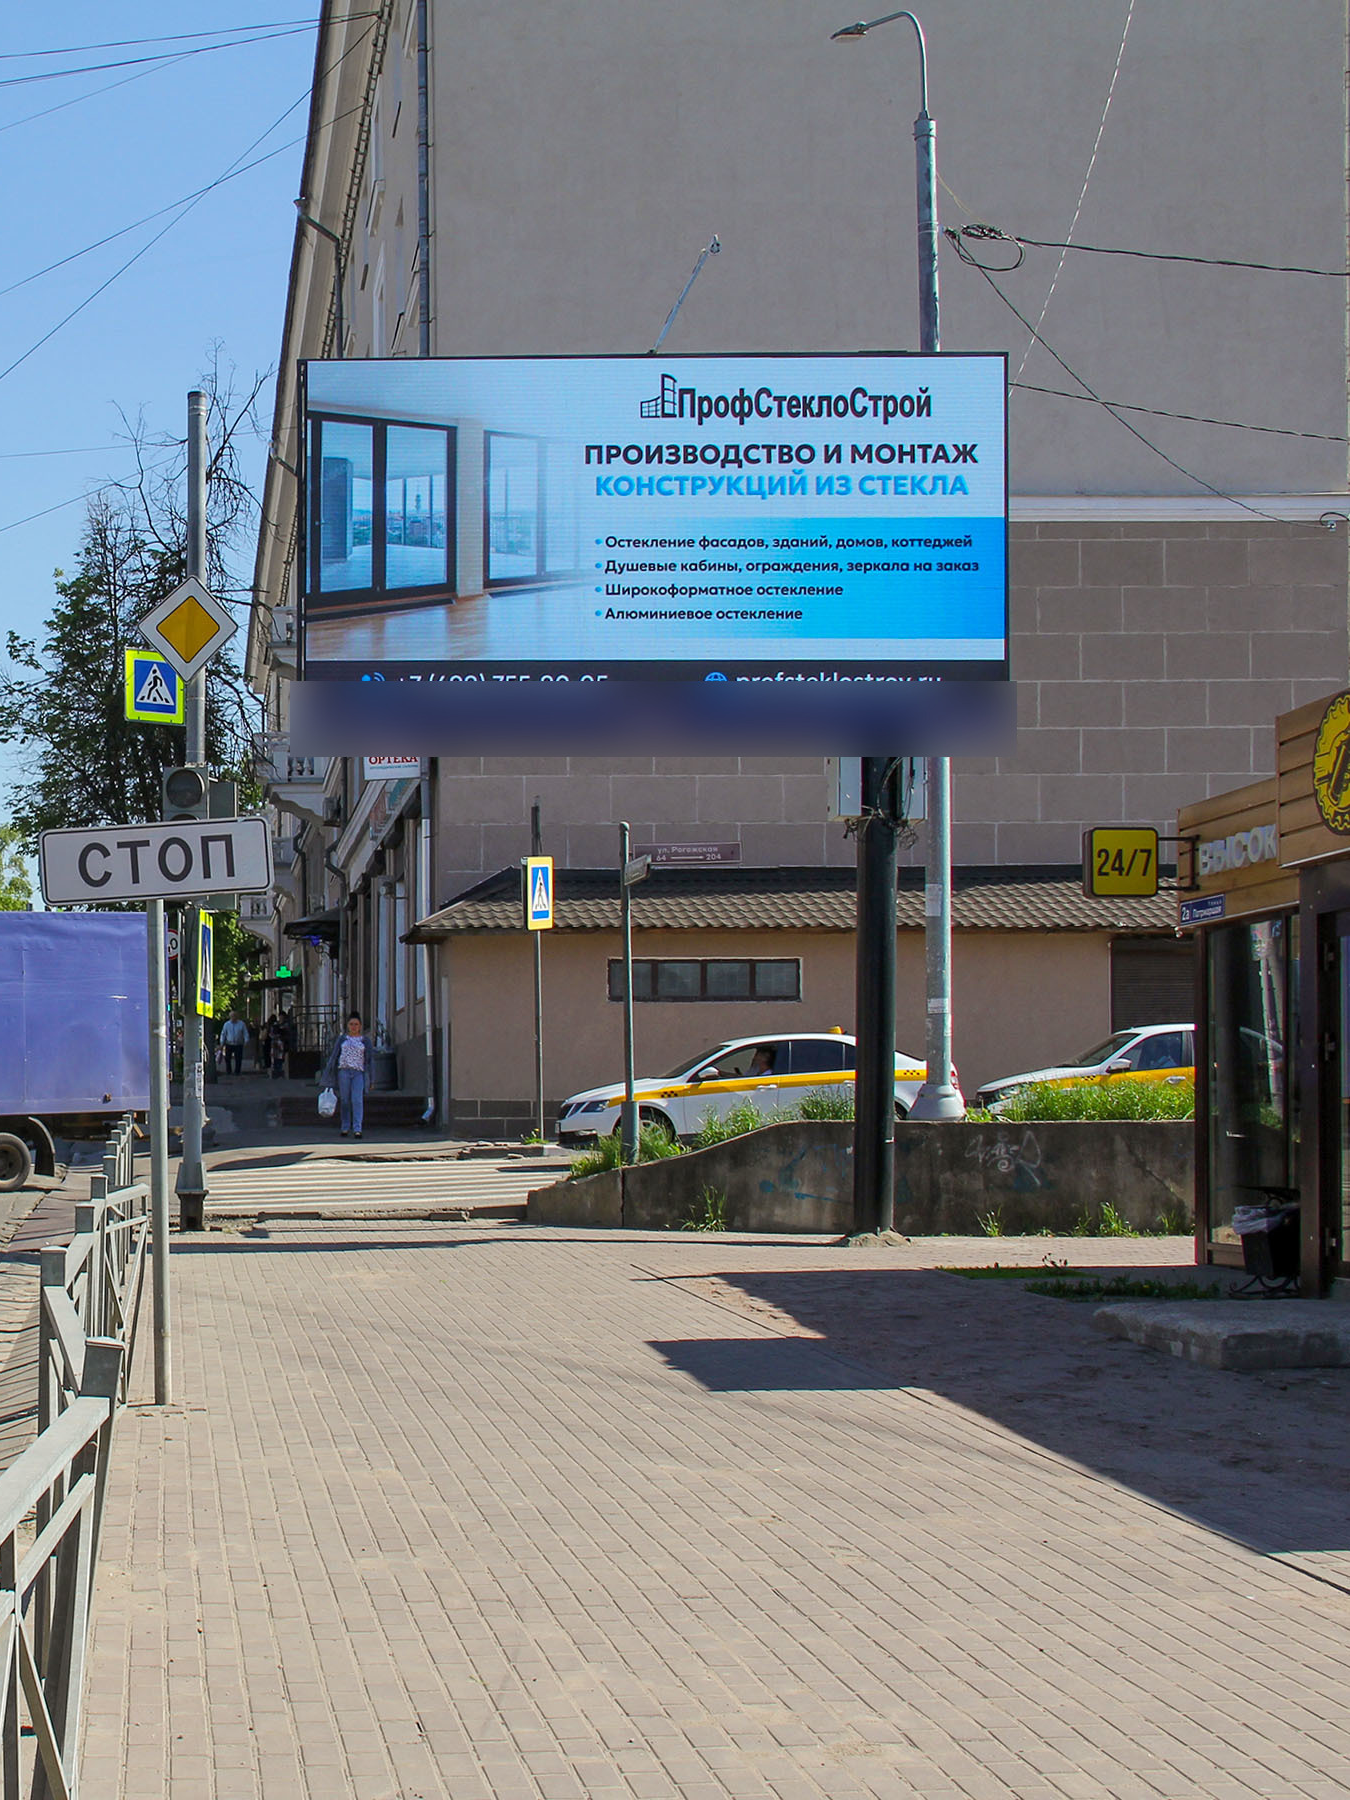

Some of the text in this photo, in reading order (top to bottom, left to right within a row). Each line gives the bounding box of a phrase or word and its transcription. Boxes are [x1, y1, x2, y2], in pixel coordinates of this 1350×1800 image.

[678, 387, 932, 425] ПрофСтеклоСтрой
[585, 443, 978, 468] ПРОИЗВОДСТВО И МОНТАЖ
[595, 469, 969, 500] КОНСТРУКЦИЙ ИЗ СТЕКЛА
[605, 535, 972, 550] Остекление фасадов, зданий, домов, коттеджей
[605, 559, 979, 574] Душевые кабины, ограждения, зеркала на заказ
[605, 584, 843, 598] Широкоформатное остекление
[605, 607, 802, 620] Алюминиевое остекление
[671, 846, 718, 854] Рогожская
[78, 833, 236, 888] СТОП
[1097, 848, 1152, 878] 24/7
